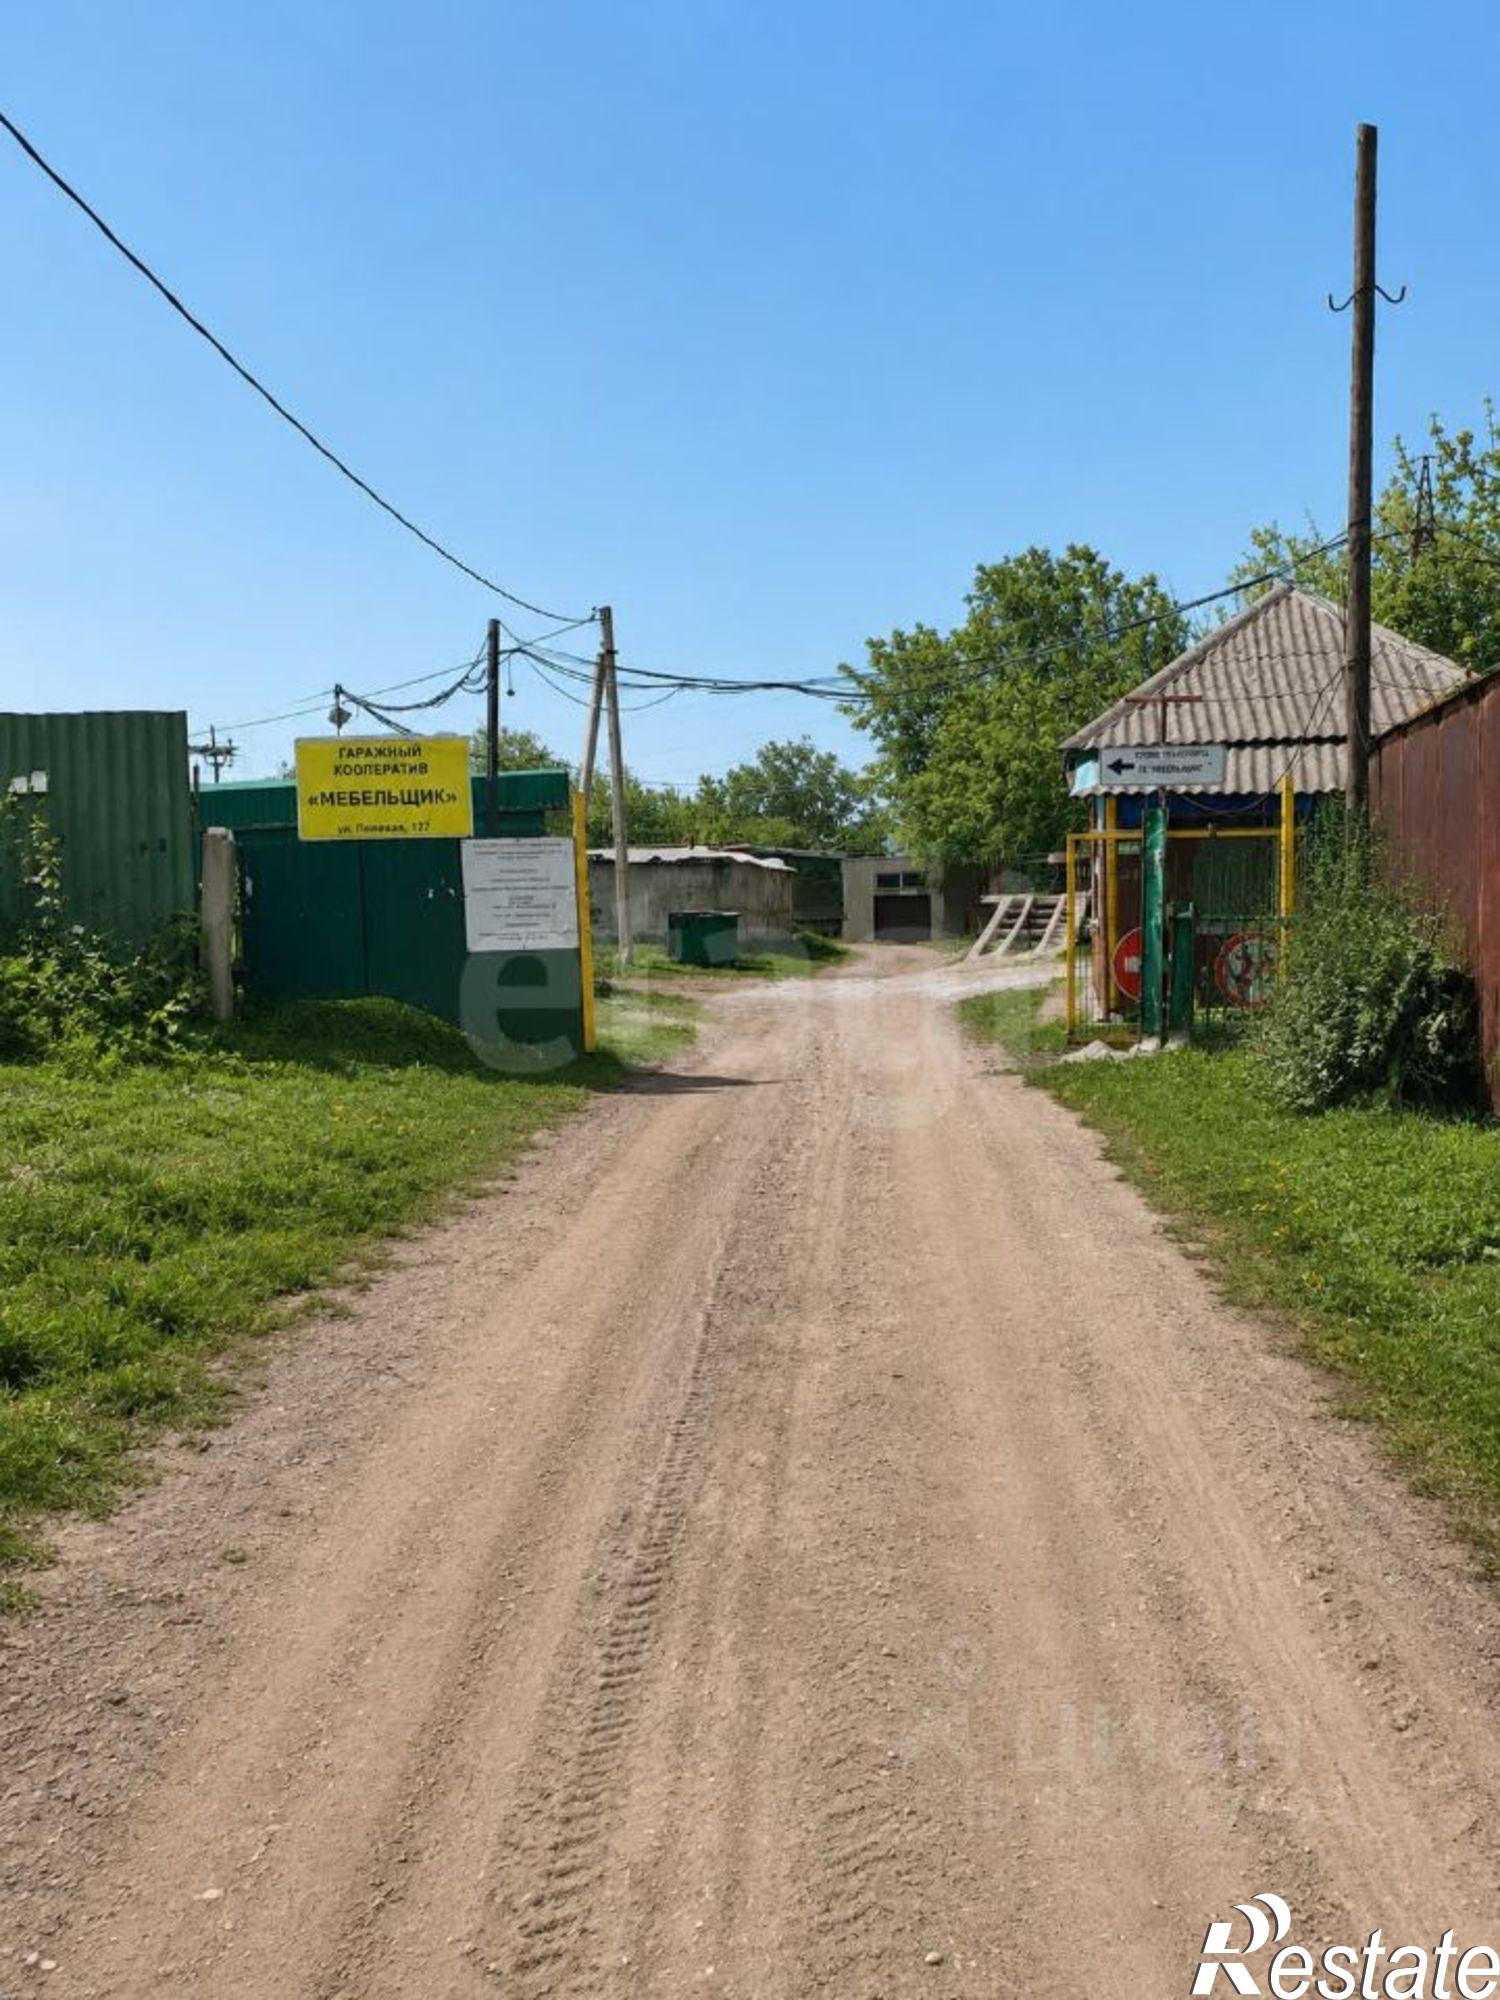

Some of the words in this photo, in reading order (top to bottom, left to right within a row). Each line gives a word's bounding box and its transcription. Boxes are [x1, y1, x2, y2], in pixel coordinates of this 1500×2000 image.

[338, 744, 423, 758] ГАРАЖНЫЙ
[333, 762, 429, 776] КООПЕРАТИВ
[308, 788, 458, 807] «МЕБЕЛЬЩИК»
